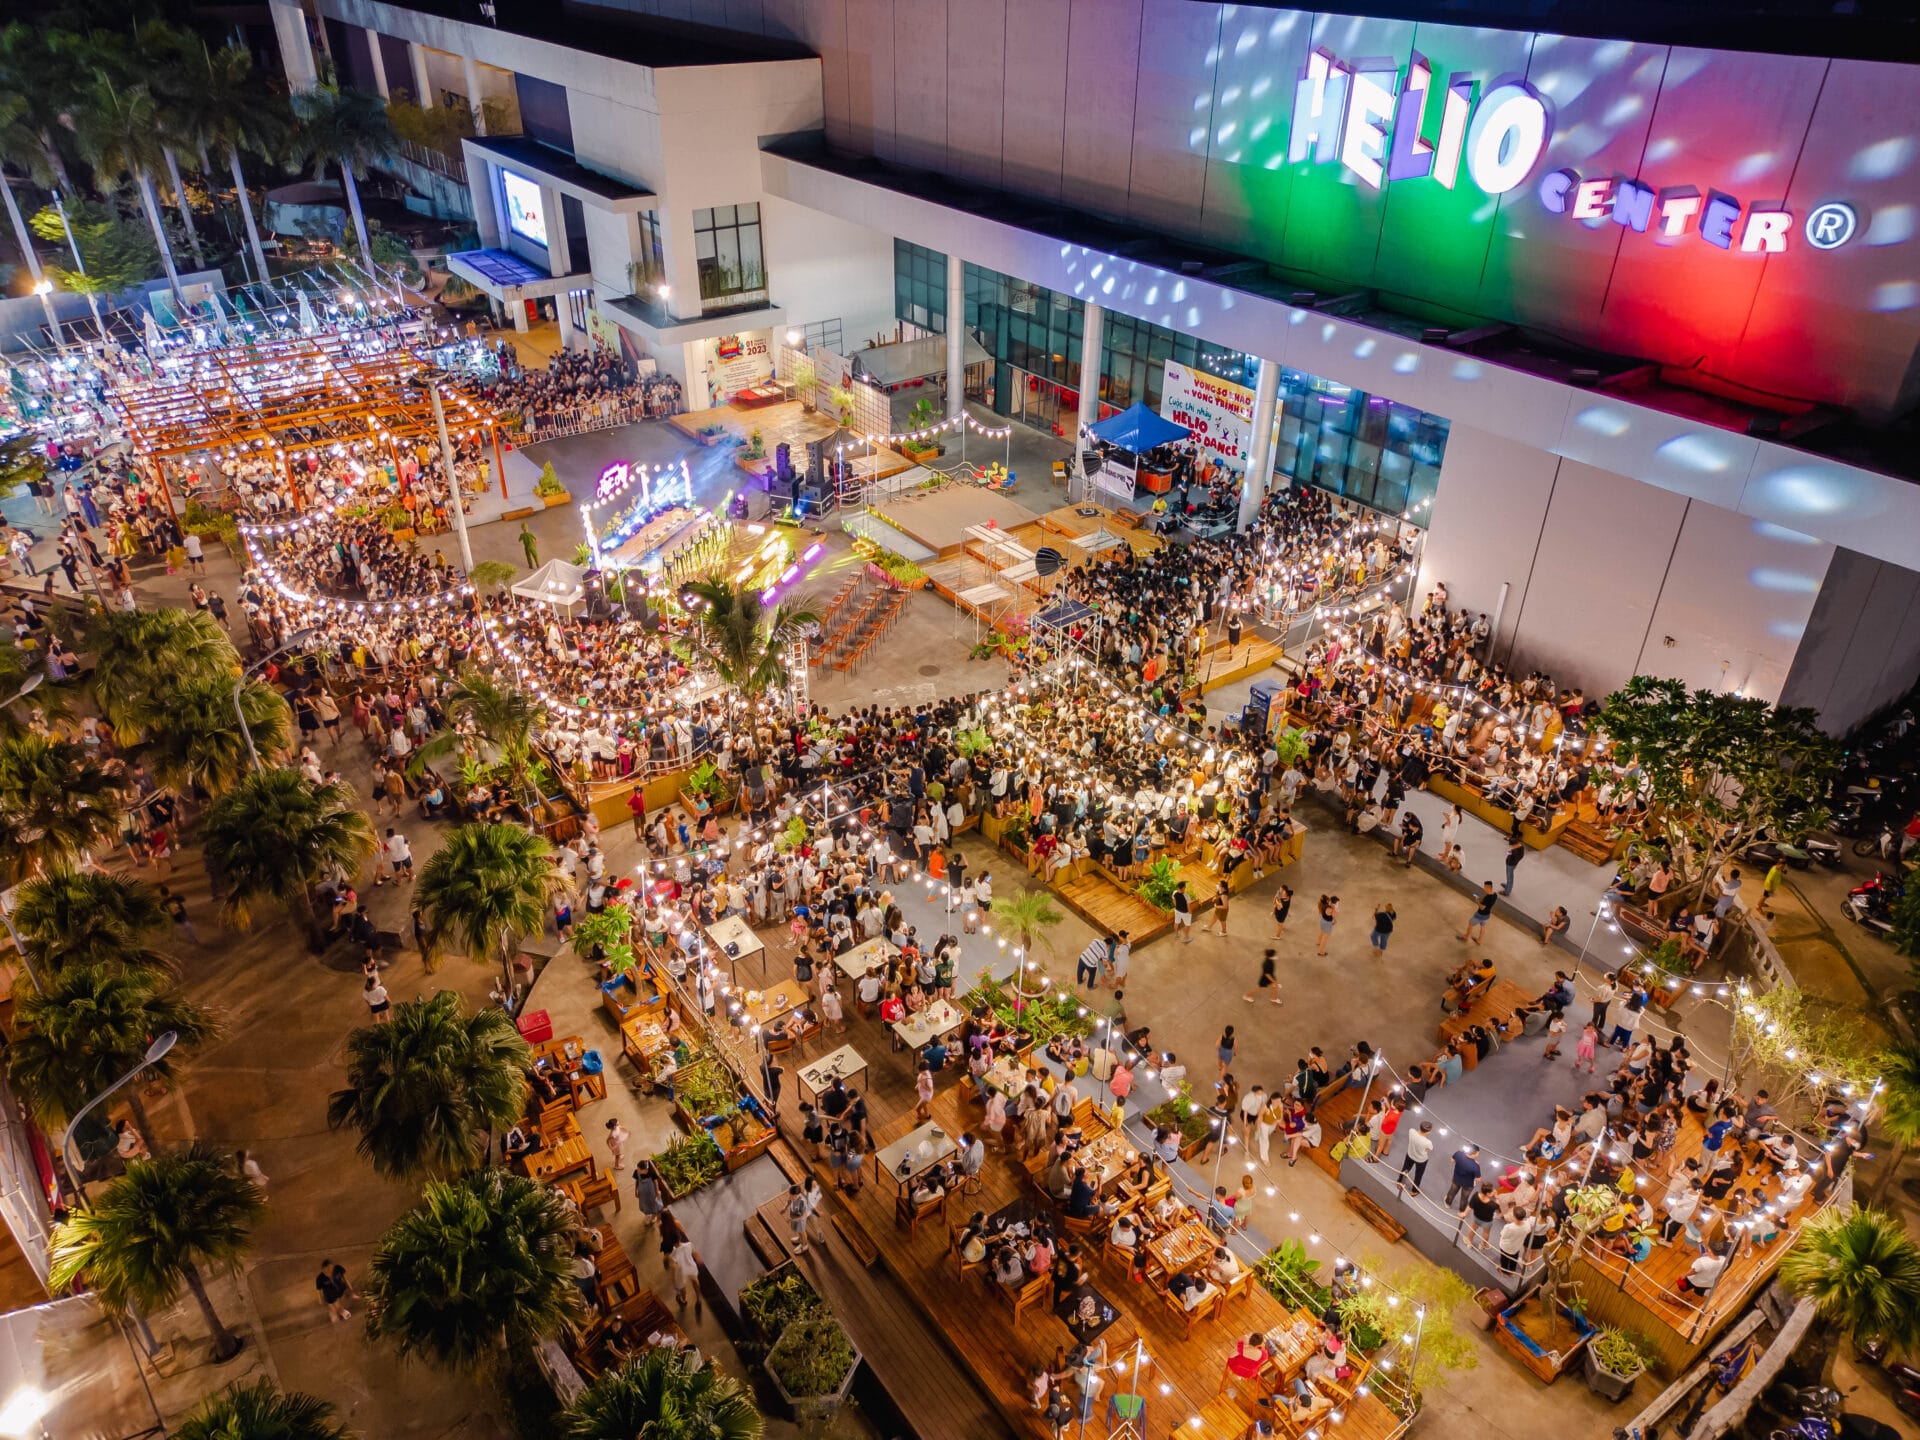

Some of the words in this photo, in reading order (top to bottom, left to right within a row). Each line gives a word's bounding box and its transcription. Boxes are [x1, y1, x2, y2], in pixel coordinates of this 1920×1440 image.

[1287, 51, 1549, 194] HELIO
[1541, 170, 1792, 253] CENTER
[747, 345, 767, 356] 2023
[1173, 410, 1208, 433] HELIO
[1204, 436, 1237, 457] DANCE
